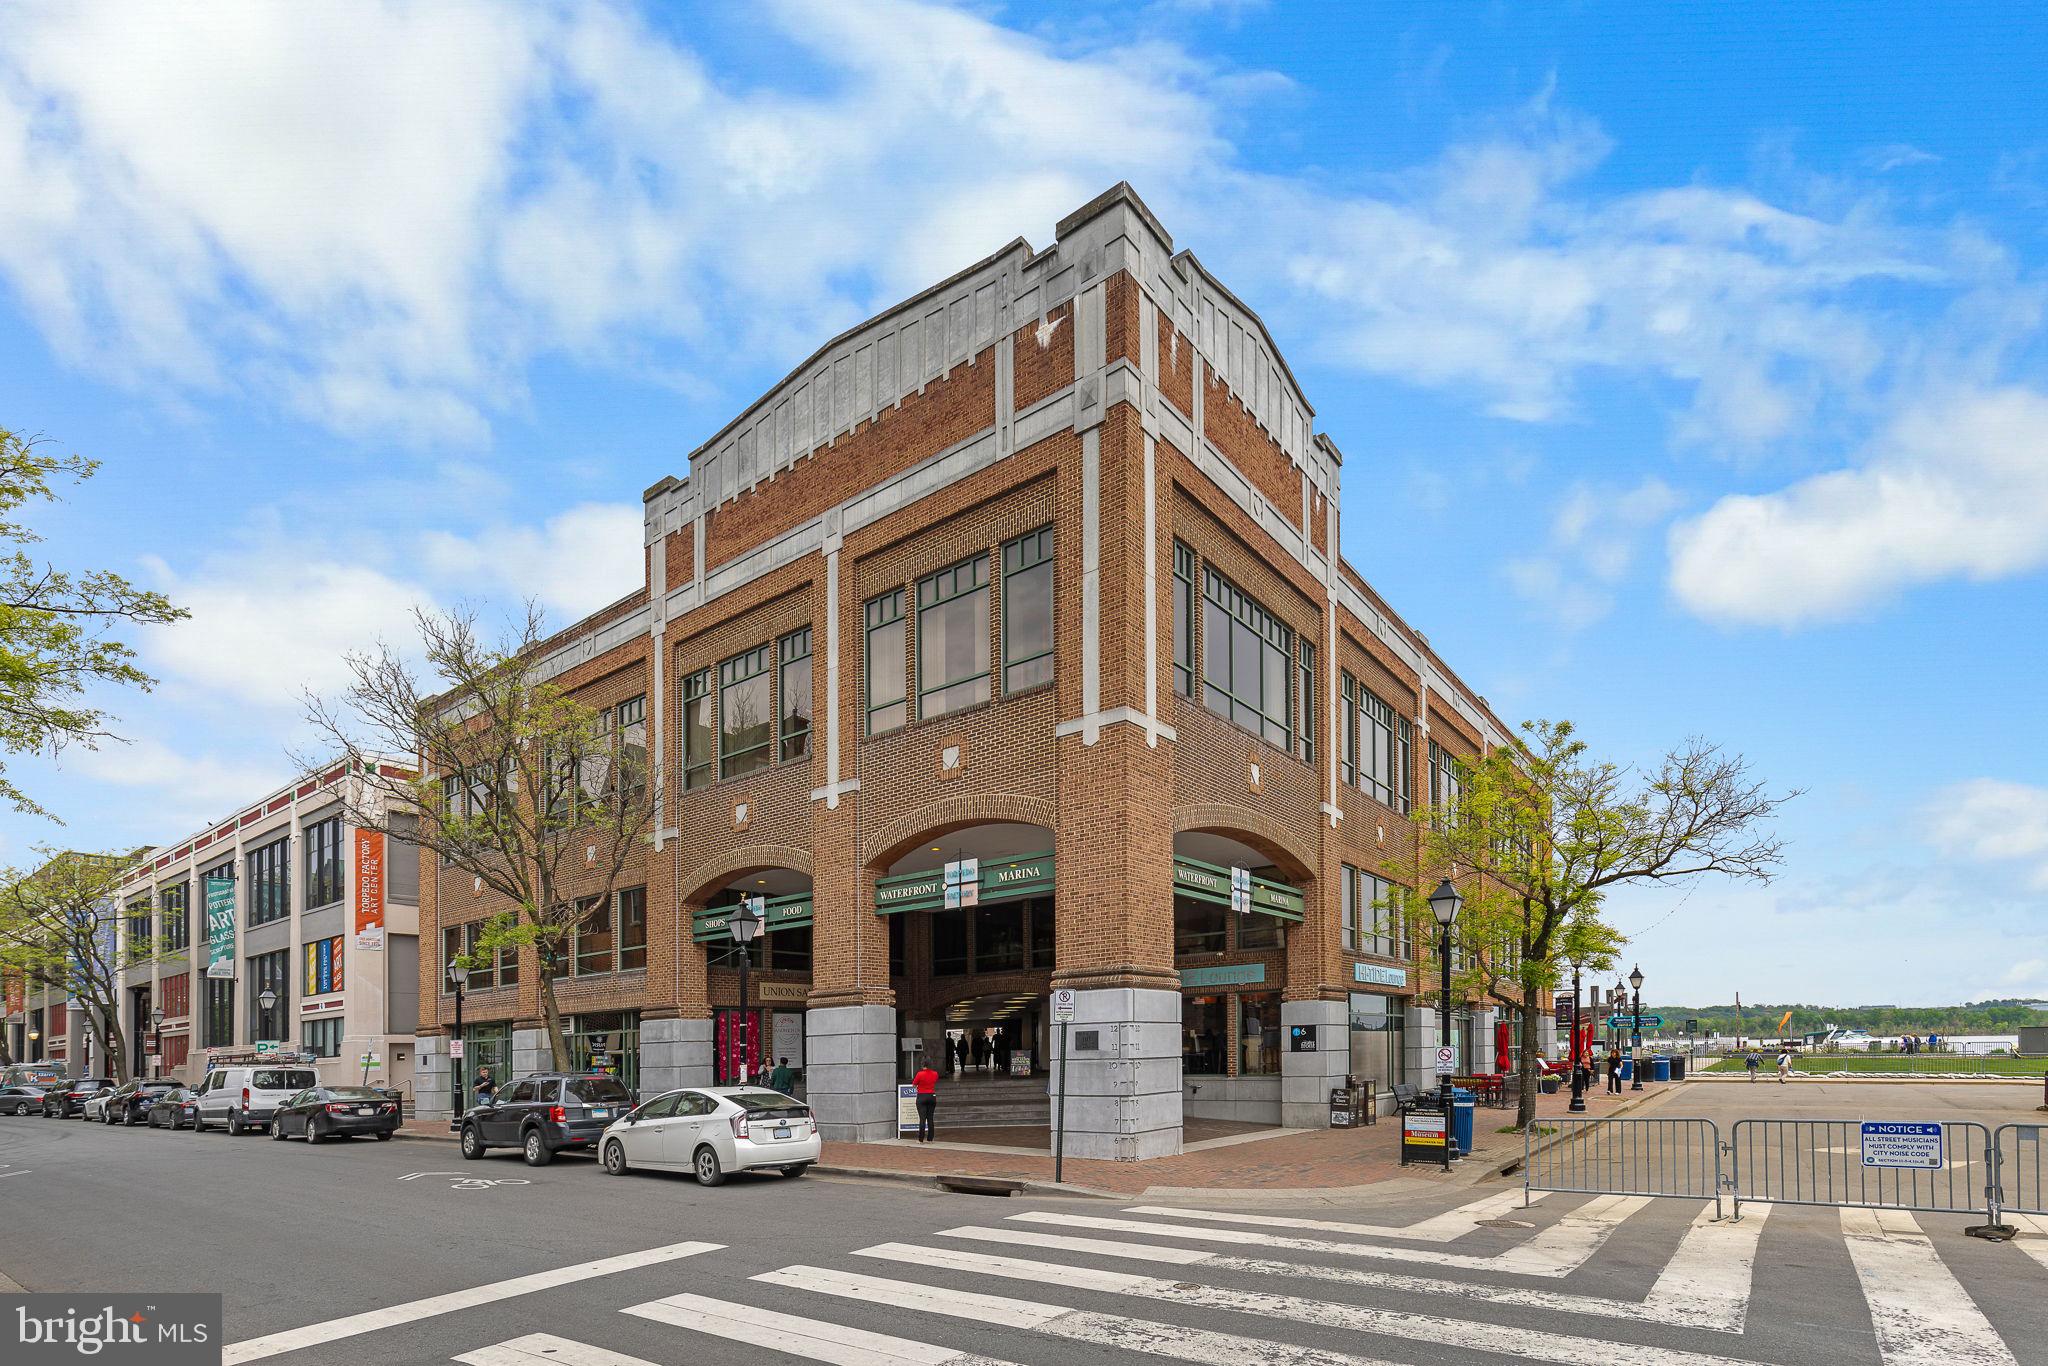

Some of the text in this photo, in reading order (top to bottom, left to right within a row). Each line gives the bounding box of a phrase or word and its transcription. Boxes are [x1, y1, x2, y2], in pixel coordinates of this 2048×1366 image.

[361, 838, 370, 914] TORPEDO FACTORY
[370, 859, 379, 914] ART CENTER
[880, 866, 1041, 901] WATERFRONT MARINA
[1177, 868, 1217, 888] WATERFRONT
[1270, 893, 1289, 906] MARINA
[208, 908, 235, 932] ART
[705, 905, 802, 929] SHOPS FOOD
[209, 930, 235, 945] GLASS
[763, 986, 795, 997] UNION
[1410, 1130, 1439, 1138] Museum
[1878, 1125, 1923, 1134] NOTICE
